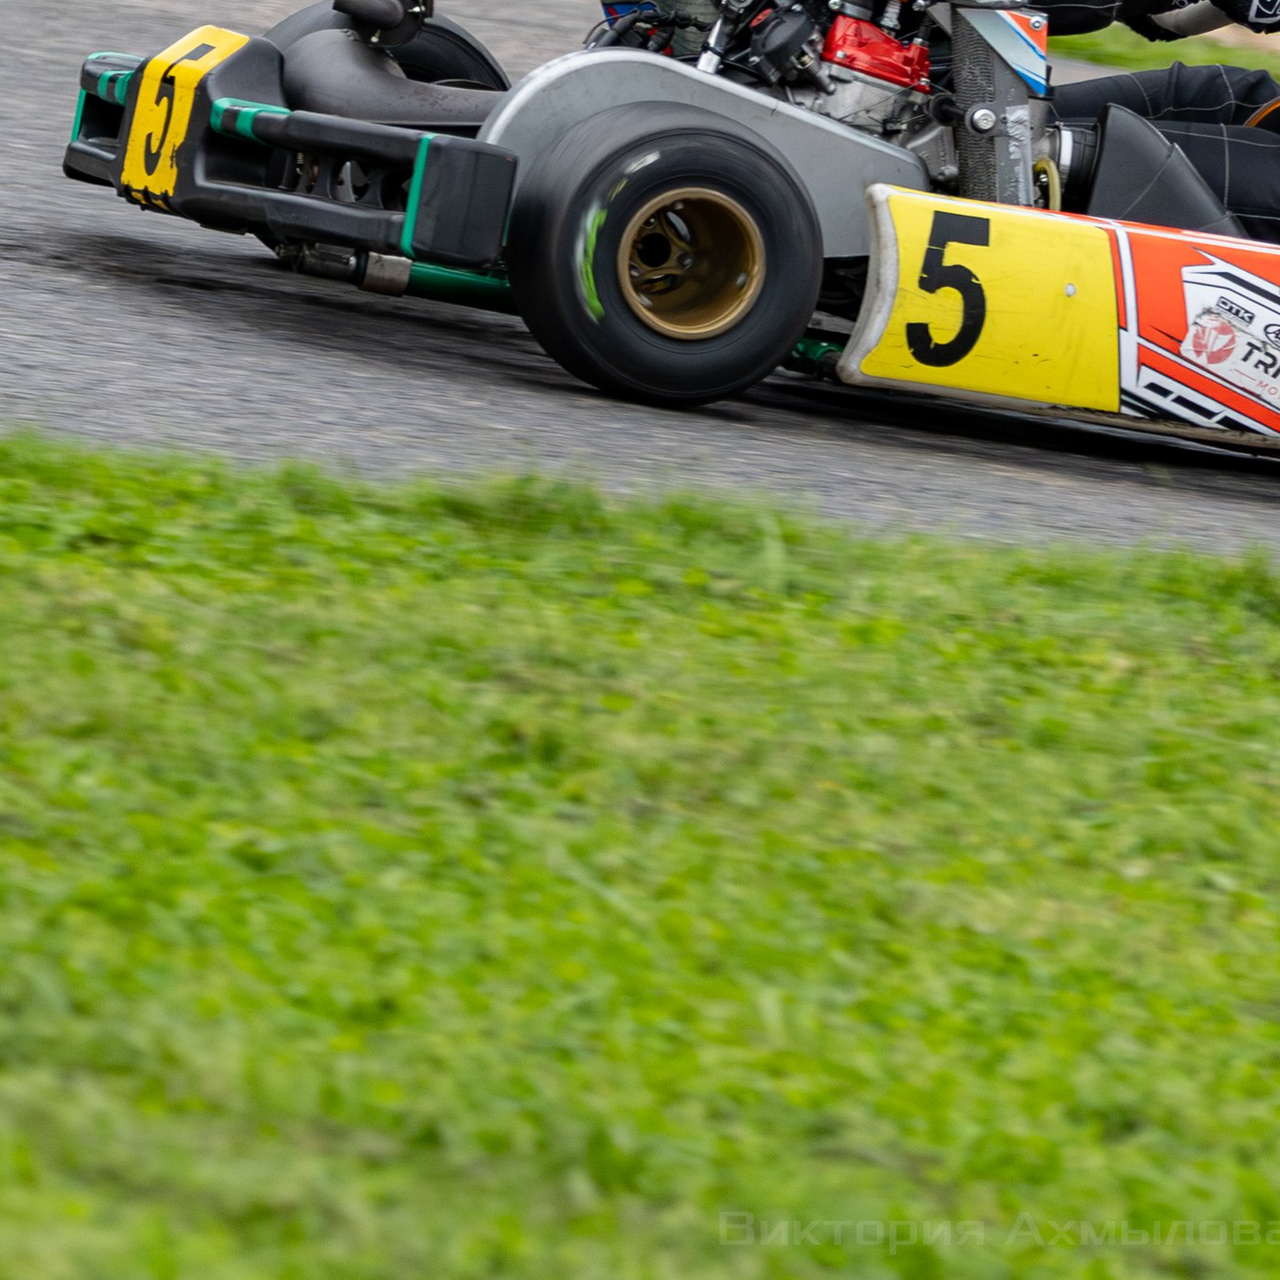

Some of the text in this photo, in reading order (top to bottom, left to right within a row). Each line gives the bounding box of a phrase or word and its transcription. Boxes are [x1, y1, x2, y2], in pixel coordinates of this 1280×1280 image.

[144, 43, 217, 177] 5
[906, 211, 991, 368] 5
[1216, 296, 1256, 325] OTK
